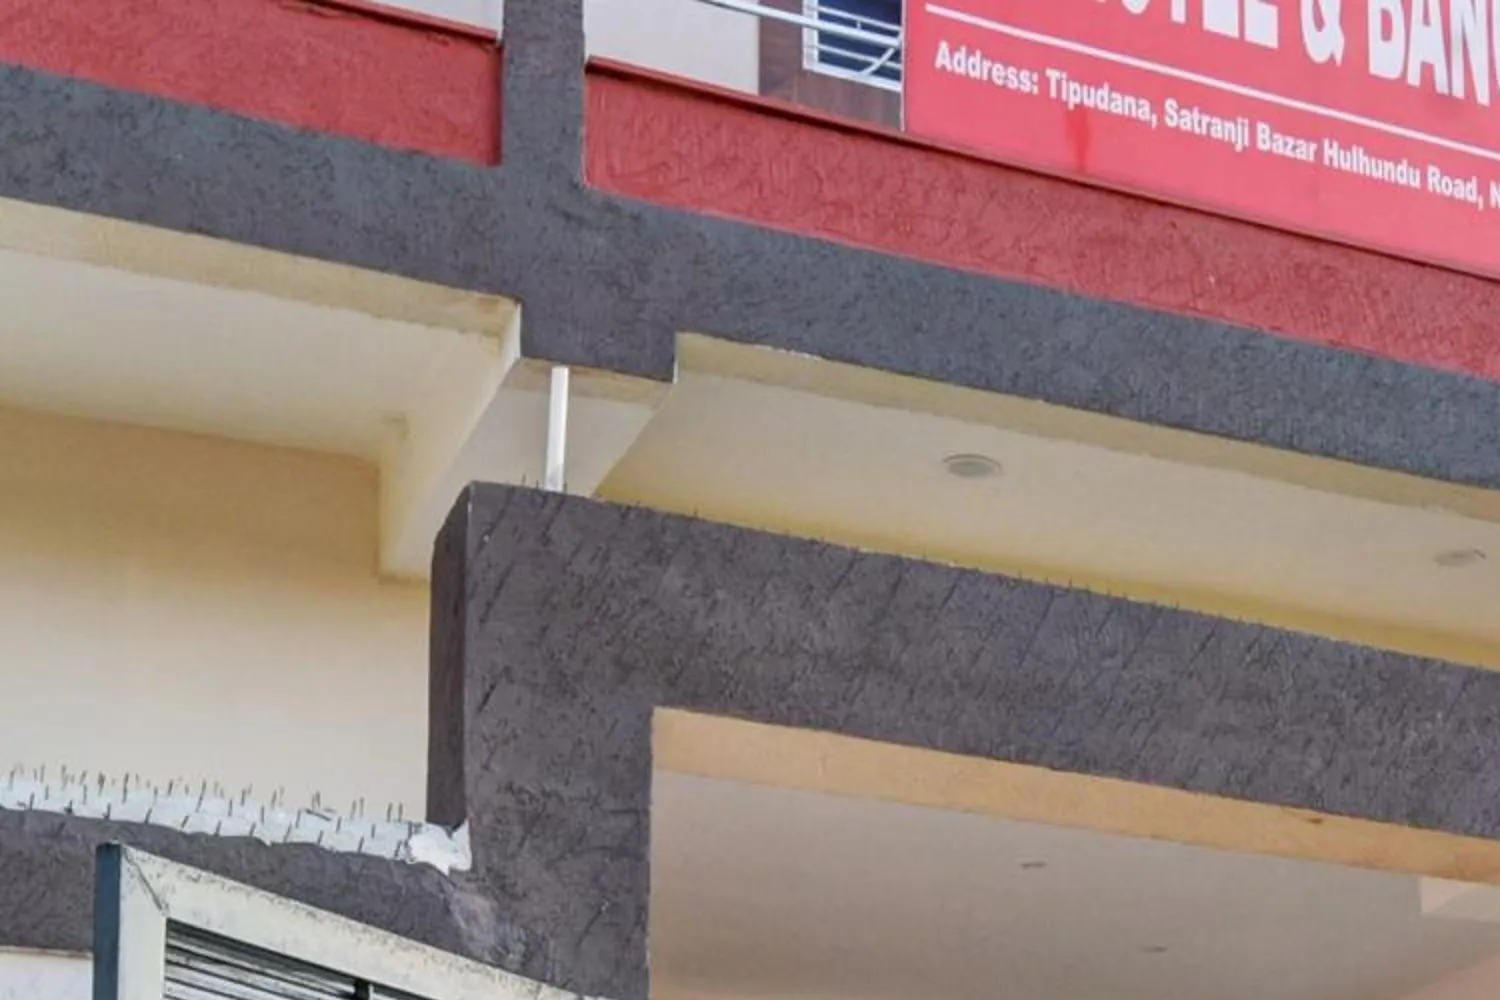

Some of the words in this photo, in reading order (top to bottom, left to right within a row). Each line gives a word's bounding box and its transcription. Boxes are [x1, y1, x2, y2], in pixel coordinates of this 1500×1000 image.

[934, 40, 1040, 95] Address:
[1046, 69, 1158, 129] Tipudana,
[1164, 98, 1250, 152] Satranji
[1256, 122, 1317, 162] Bazar
[1323, 138, 1421, 189] Hulhundu
[1427, 165, 1485, 210] Road,
